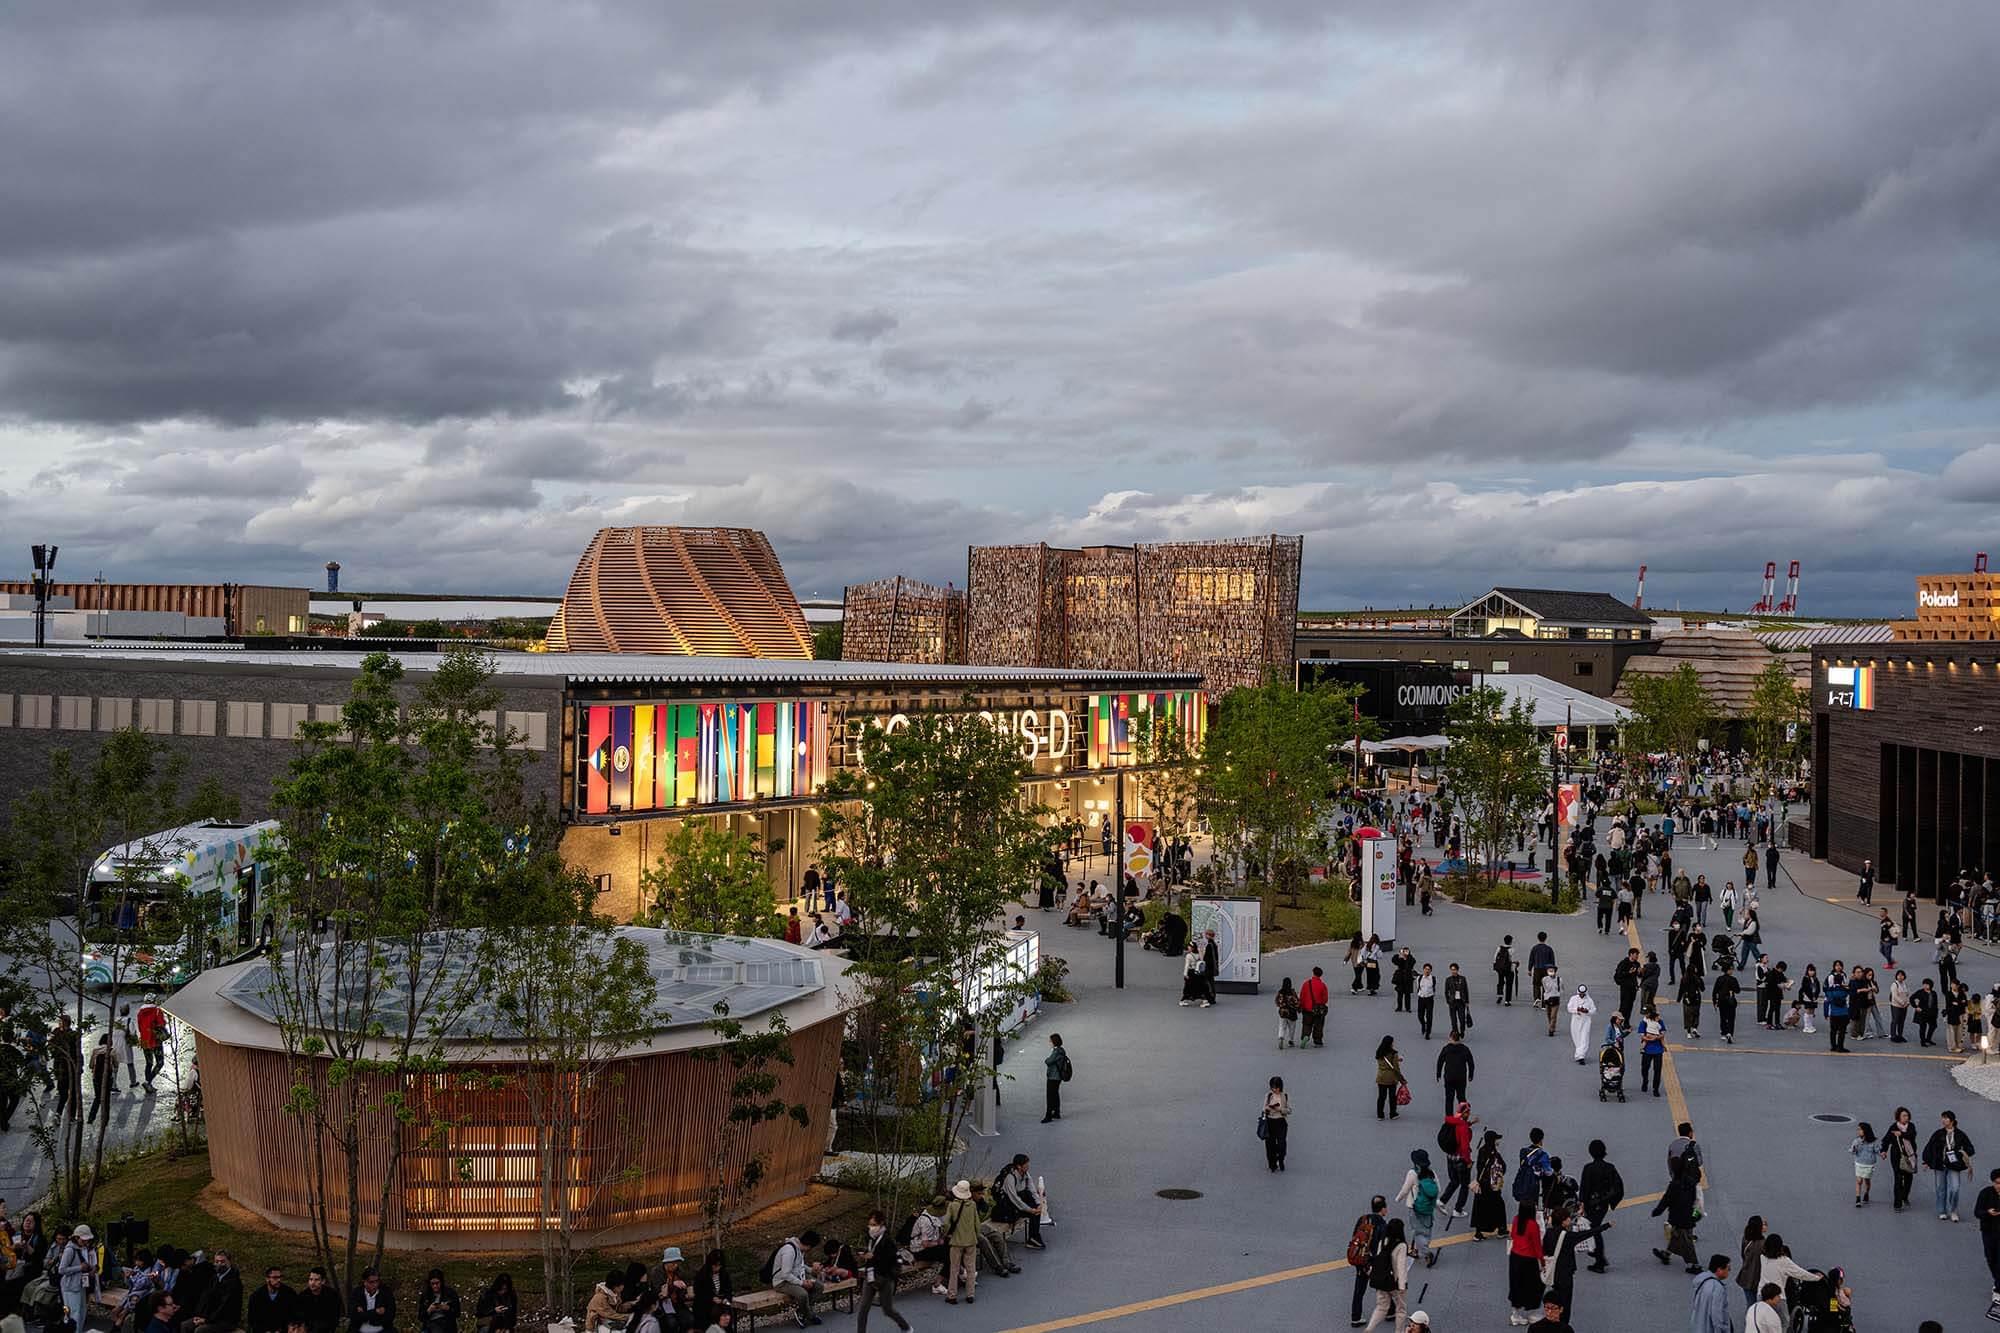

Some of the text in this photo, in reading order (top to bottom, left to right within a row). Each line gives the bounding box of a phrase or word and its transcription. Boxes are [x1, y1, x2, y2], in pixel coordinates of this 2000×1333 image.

[1920, 590, 1958, 607] Poland
[1828, 691, 1854, 708] ルーマニア
